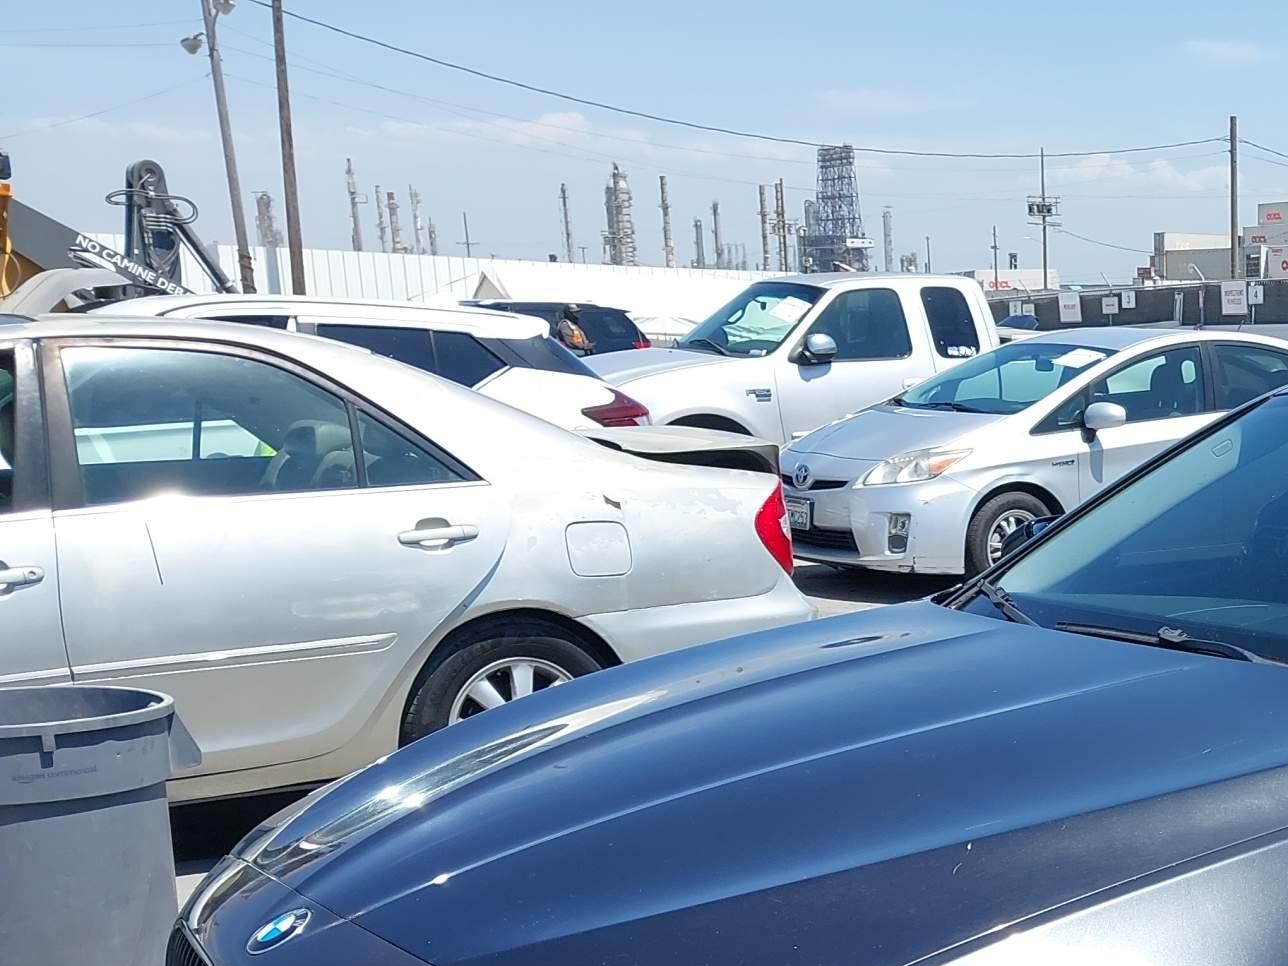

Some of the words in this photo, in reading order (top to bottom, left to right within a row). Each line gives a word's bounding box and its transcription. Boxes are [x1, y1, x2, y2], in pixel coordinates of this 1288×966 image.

[75, 235, 100, 253] NO
[102, 250, 157, 284] CAMINE
[1253, 289, 1259, 300] 4
